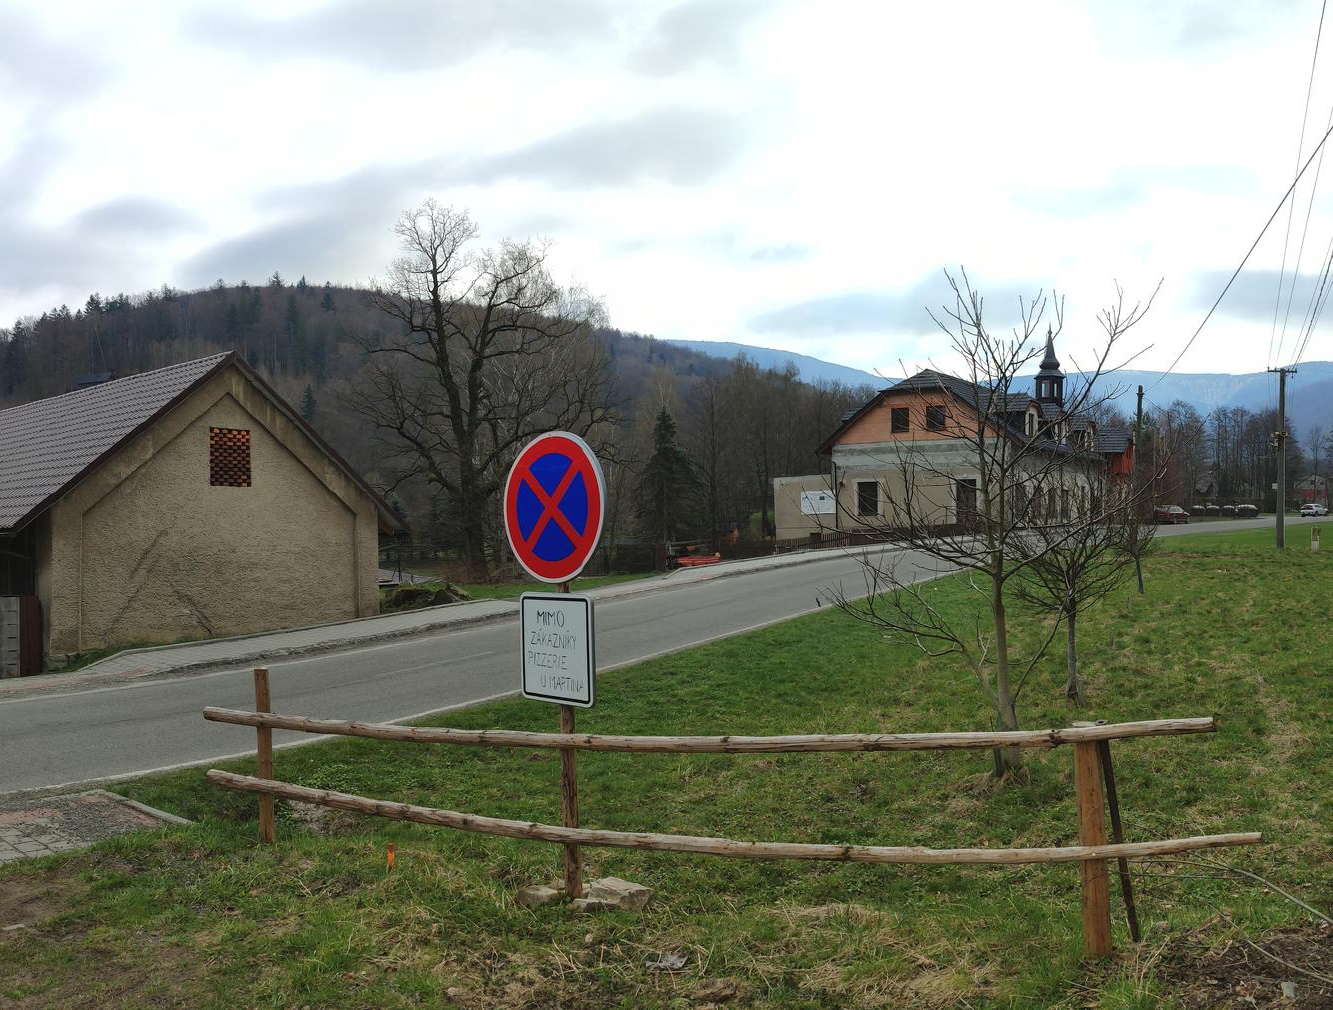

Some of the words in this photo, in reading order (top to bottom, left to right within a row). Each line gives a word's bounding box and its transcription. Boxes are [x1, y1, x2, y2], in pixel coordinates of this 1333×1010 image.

[536, 610, 565, 627] MIMO
[530, 628, 576, 650] ZÁKAZNÍKY
[528, 651, 567, 670] PIZZERIE
[540, 674, 546, 688] U
[549, 675, 584, 692] MARTINA
